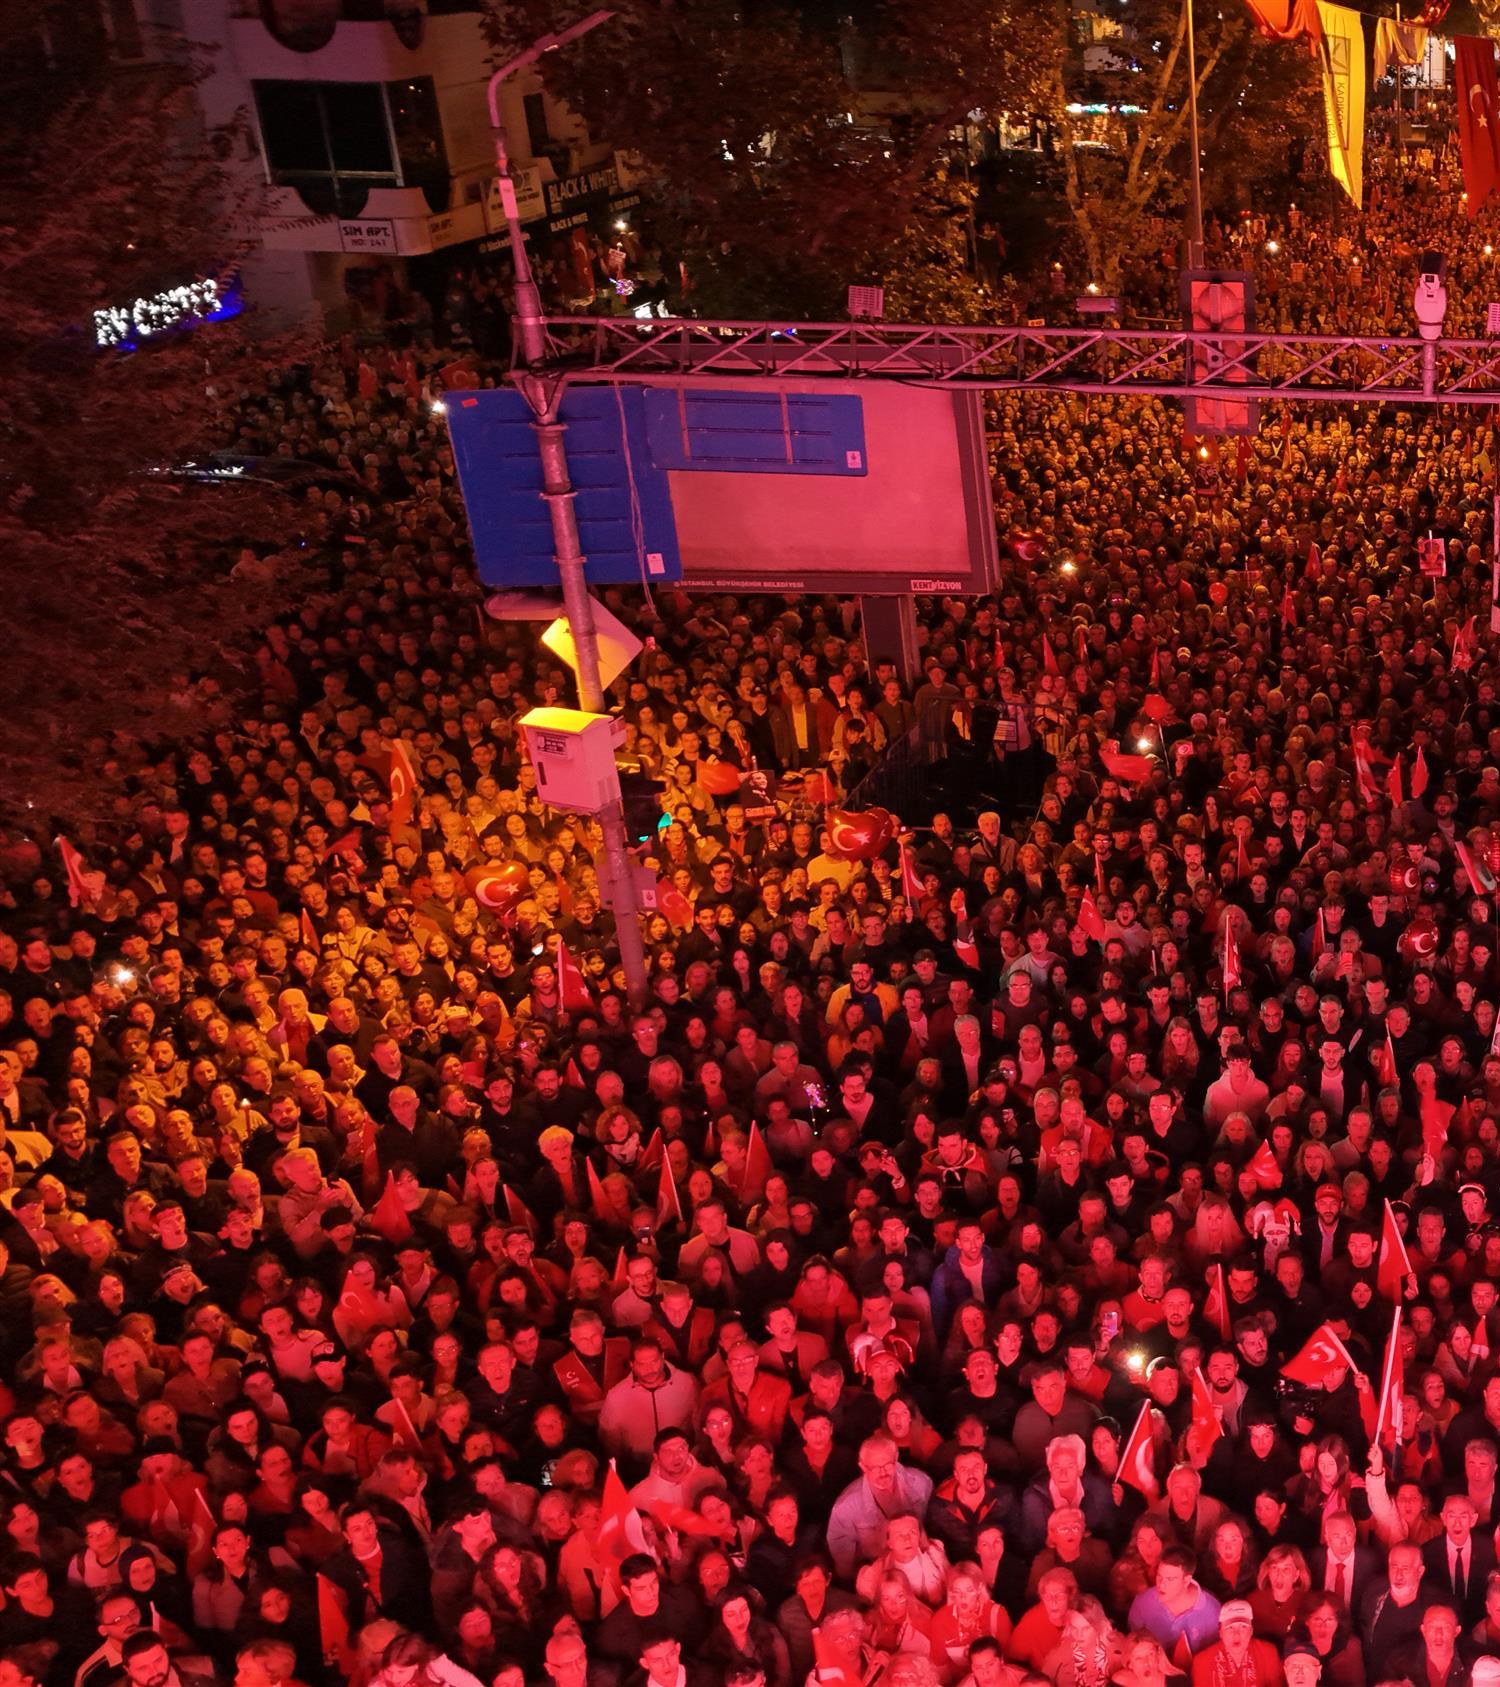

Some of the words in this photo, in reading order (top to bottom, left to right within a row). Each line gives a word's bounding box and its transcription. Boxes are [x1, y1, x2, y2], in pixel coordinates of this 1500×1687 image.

[548, 177, 578, 203] BLACK
[580, 175, 588, 194] &
[589, 167, 618, 192] WHITE
